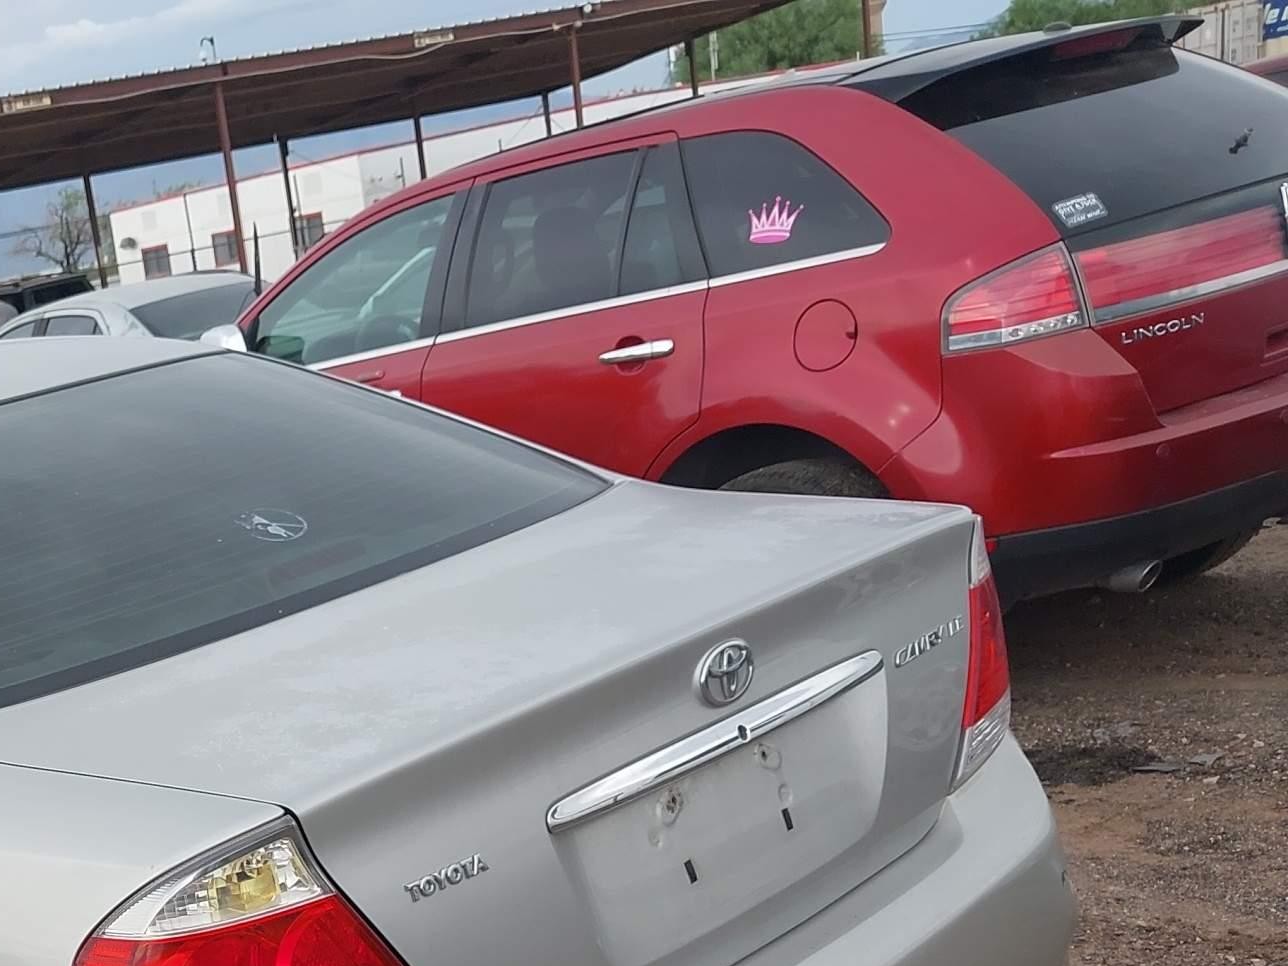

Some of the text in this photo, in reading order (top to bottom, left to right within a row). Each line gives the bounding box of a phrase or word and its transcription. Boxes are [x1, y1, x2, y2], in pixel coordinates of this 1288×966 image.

[1121, 312, 1205, 344] LINCOLN
[894, 624, 946, 668] CAMRY
[403, 853, 490, 903] TOYOTA
